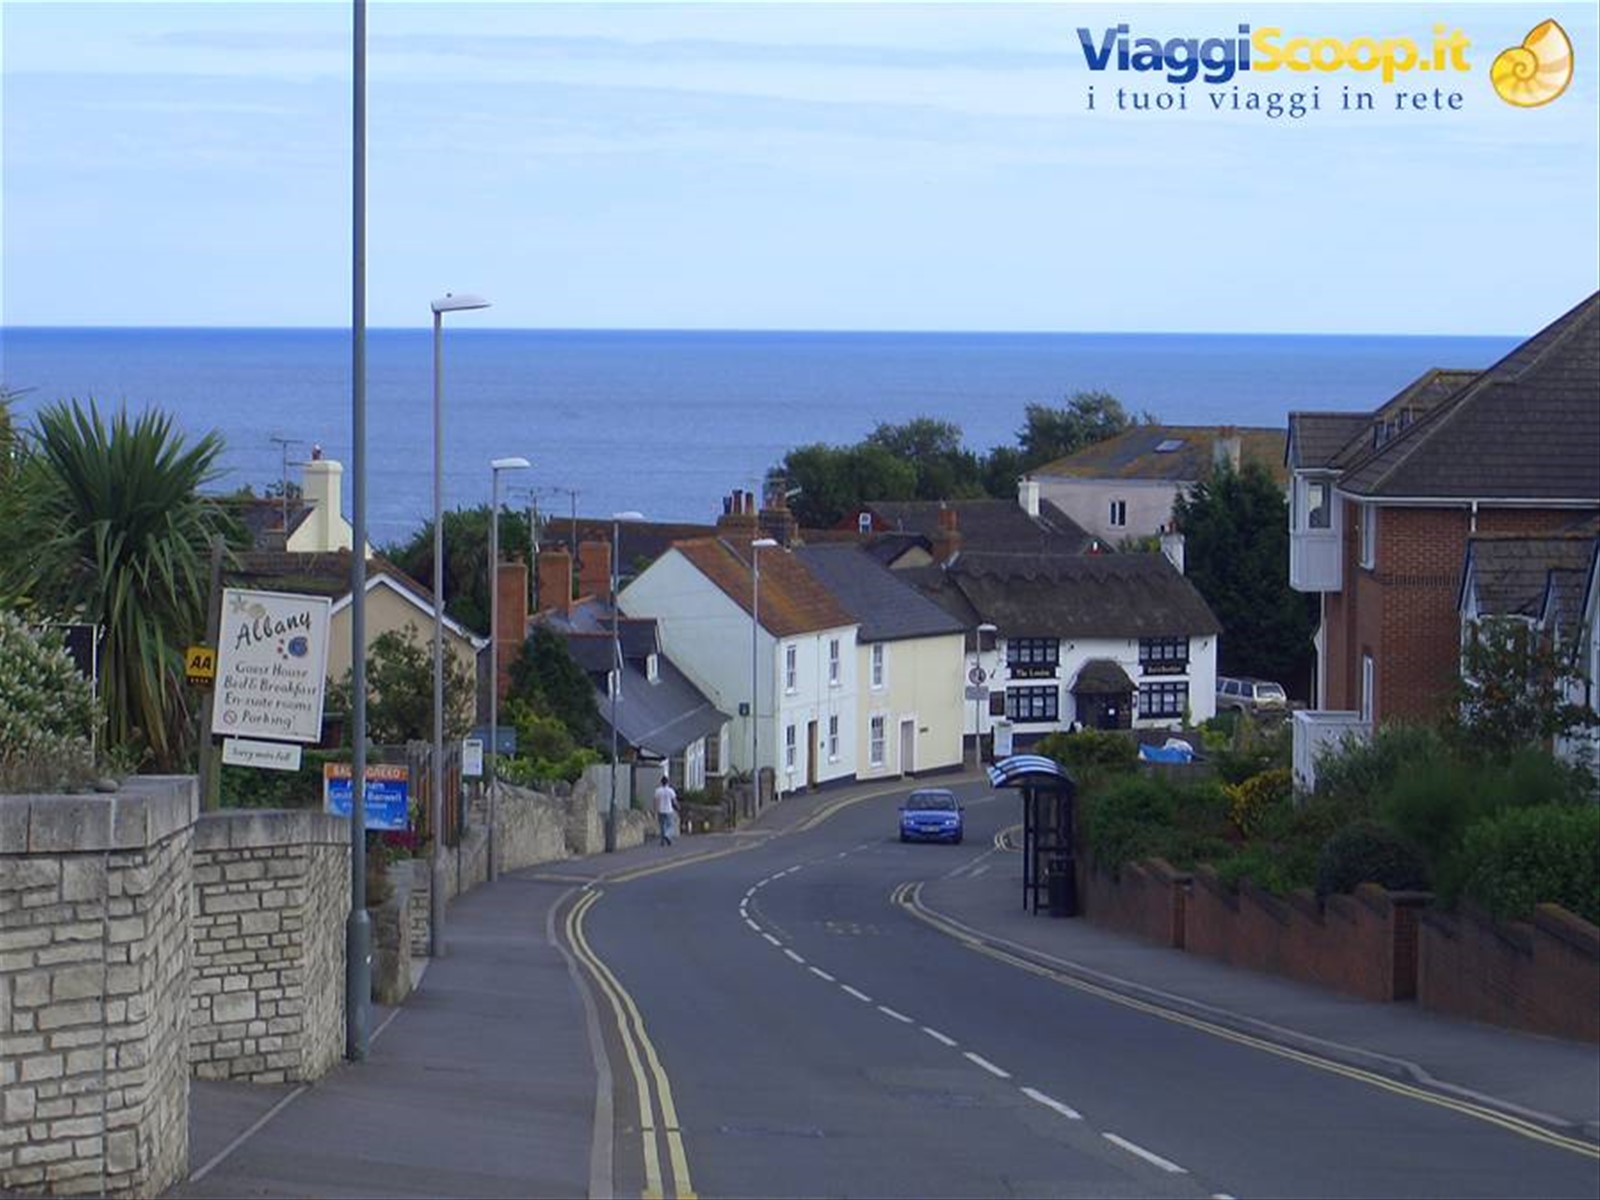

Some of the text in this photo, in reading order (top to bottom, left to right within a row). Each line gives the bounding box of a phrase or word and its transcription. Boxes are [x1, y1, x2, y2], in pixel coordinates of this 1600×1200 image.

[234, 611, 312, 651] Albany
[190, 655, 212, 670] AA
[272, 663, 309, 677] House
